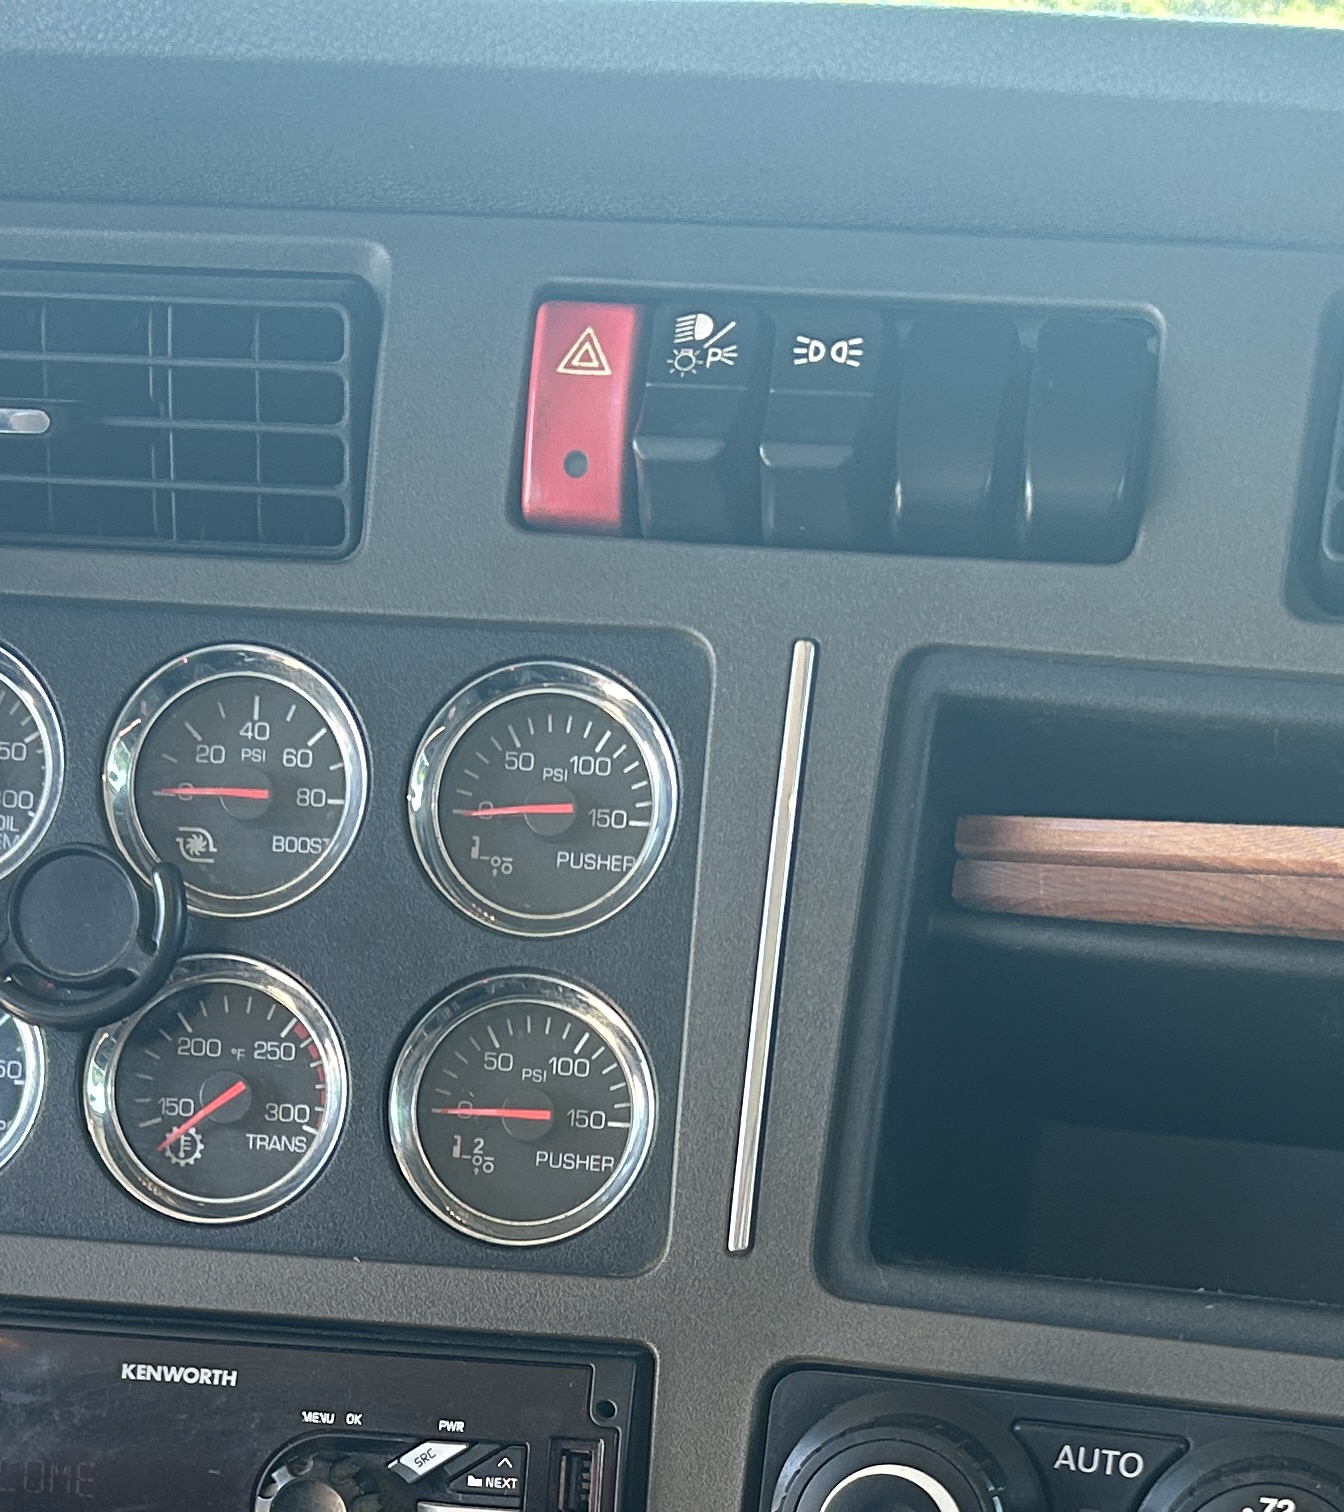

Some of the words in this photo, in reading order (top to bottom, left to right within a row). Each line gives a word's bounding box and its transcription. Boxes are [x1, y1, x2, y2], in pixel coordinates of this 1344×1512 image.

[239, 722, 270, 740] 40
[196, 745, 225, 764] 20
[241, 749, 266, 763] PSI
[283, 749, 313, 767] 60
[505, 752, 534, 771] 50
[543, 768, 568, 781] PSI
[570, 756, 611, 776] 100
[296, 789, 326, 807] 80
[588, 809, 627, 828] 150
[557, 851, 636, 872] PUSHER
[178, 1038, 221, 1057] 200
[254, 1042, 295, 1061] 250
[484, 1053, 513, 1072] 50
[548, 1057, 590, 1078] 100
[522, 1068, 547, 1082] PSI
[158, 1098, 194, 1117] 150
[264, 1104, 310, 1123] 300
[567, 1110, 606, 1130] 150
[246, 1134, 306, 1153] TRANS
[473, 1138, 484, 1154] 2
[535, 1151, 615, 1172] PUSHER
[121, 1362, 239, 1388] KENWORTH
[345, 1413, 363, 1427] OK
[438, 1419, 465, 1433] PWR
[413, 1447, 437, 1469] SRC
[1053, 1444, 1145, 1480] AUTO
[485, 1476, 518, 1489] NEXT
